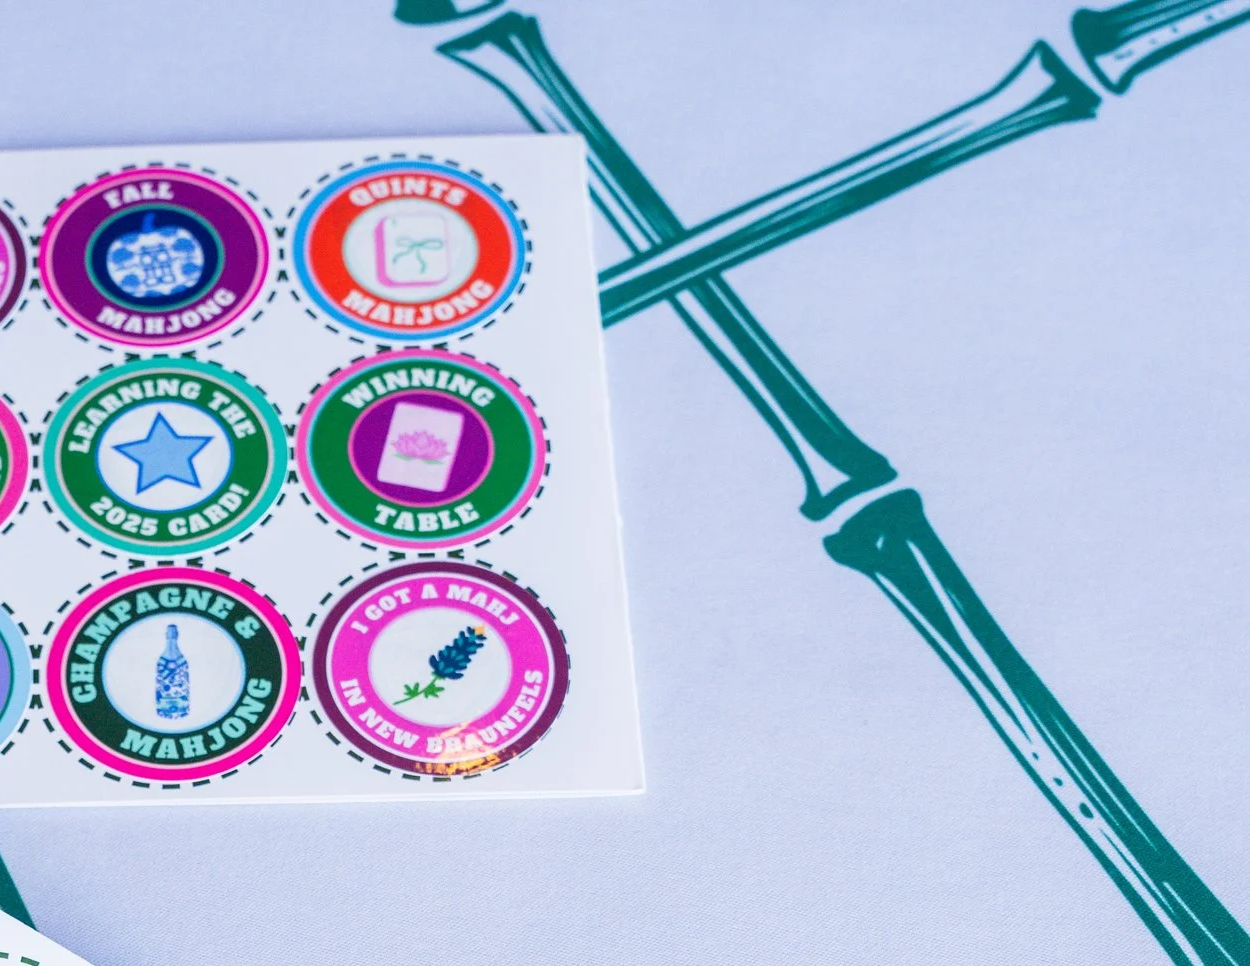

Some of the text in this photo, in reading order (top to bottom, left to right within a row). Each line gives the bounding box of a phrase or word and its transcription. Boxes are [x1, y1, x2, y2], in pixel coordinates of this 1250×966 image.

[102, 181, 175, 210] FALL
[348, 176, 468, 206] QUINTS
[96, 288, 237, 335] MAHJONG
[341, 279, 494, 326] MAHJONG
[341, 367, 496, 409] WINNING
[68, 378, 258, 454] LEARNING THE
[89, 482, 250, 537] 2025 CARD!
[373, 501, 480, 532] TABLE
[350, 583, 520, 635] I GOT A MAHJ
[69, 587, 261, 704] CHAMPAGNE &
[119, 678, 272, 760] MAHJONG
[340, 670, 544, 754] IN NEW BRAUNFELS
